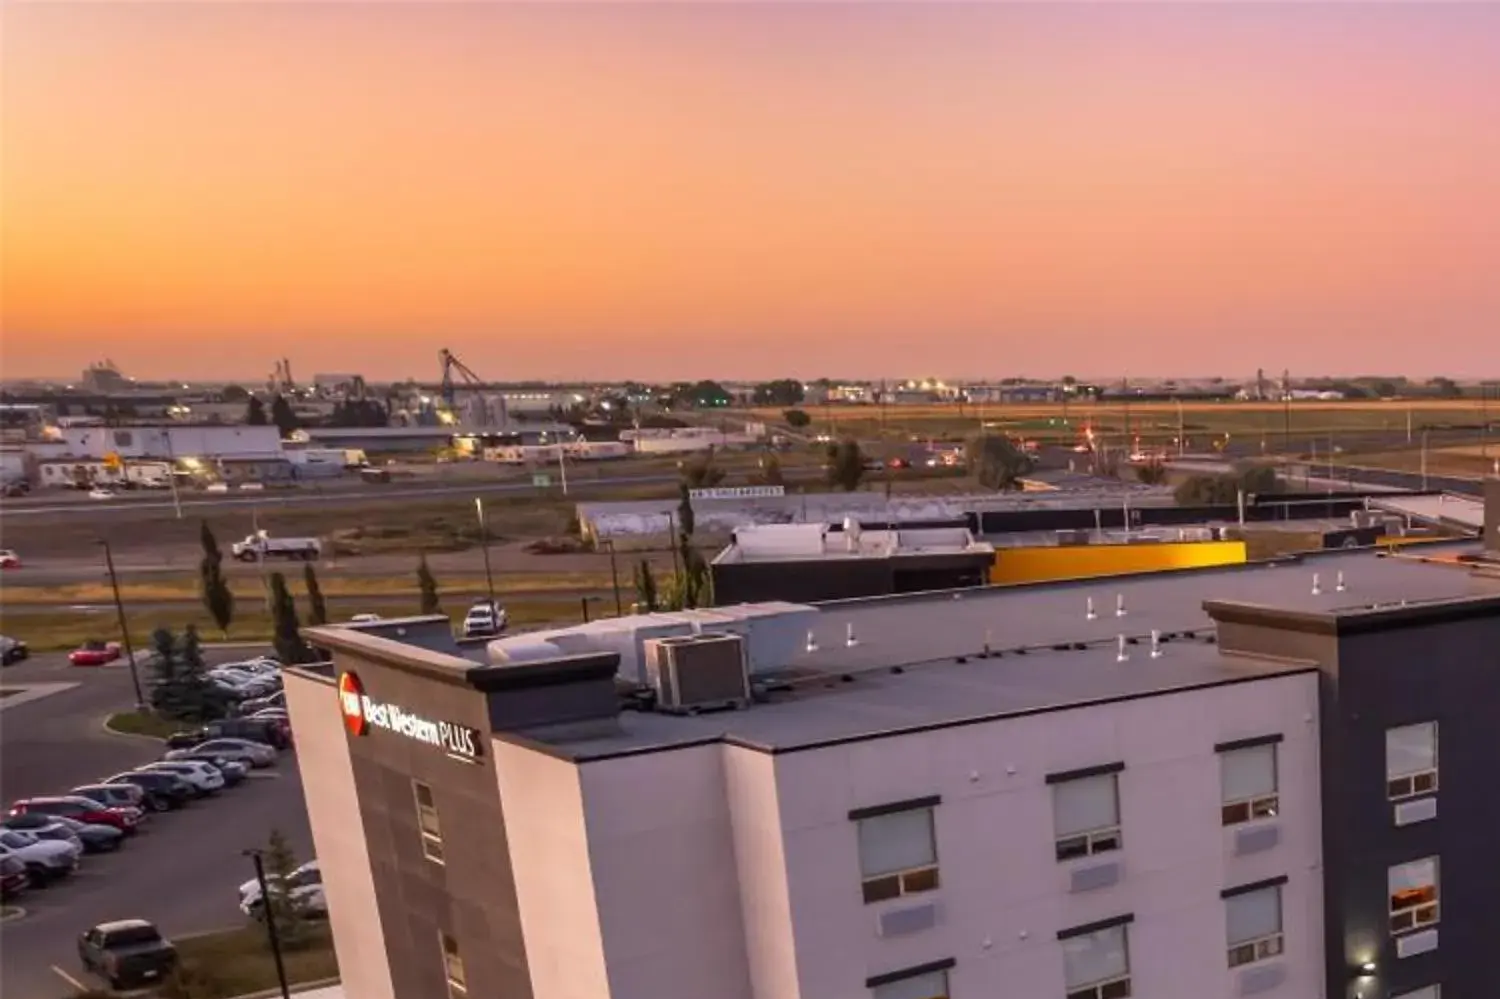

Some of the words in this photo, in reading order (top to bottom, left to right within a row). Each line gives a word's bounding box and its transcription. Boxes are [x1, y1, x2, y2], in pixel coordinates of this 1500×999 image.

[361, 695, 391, 729] Best
[387, 703, 441, 746] Western
[439, 720, 475, 757] PLUS
